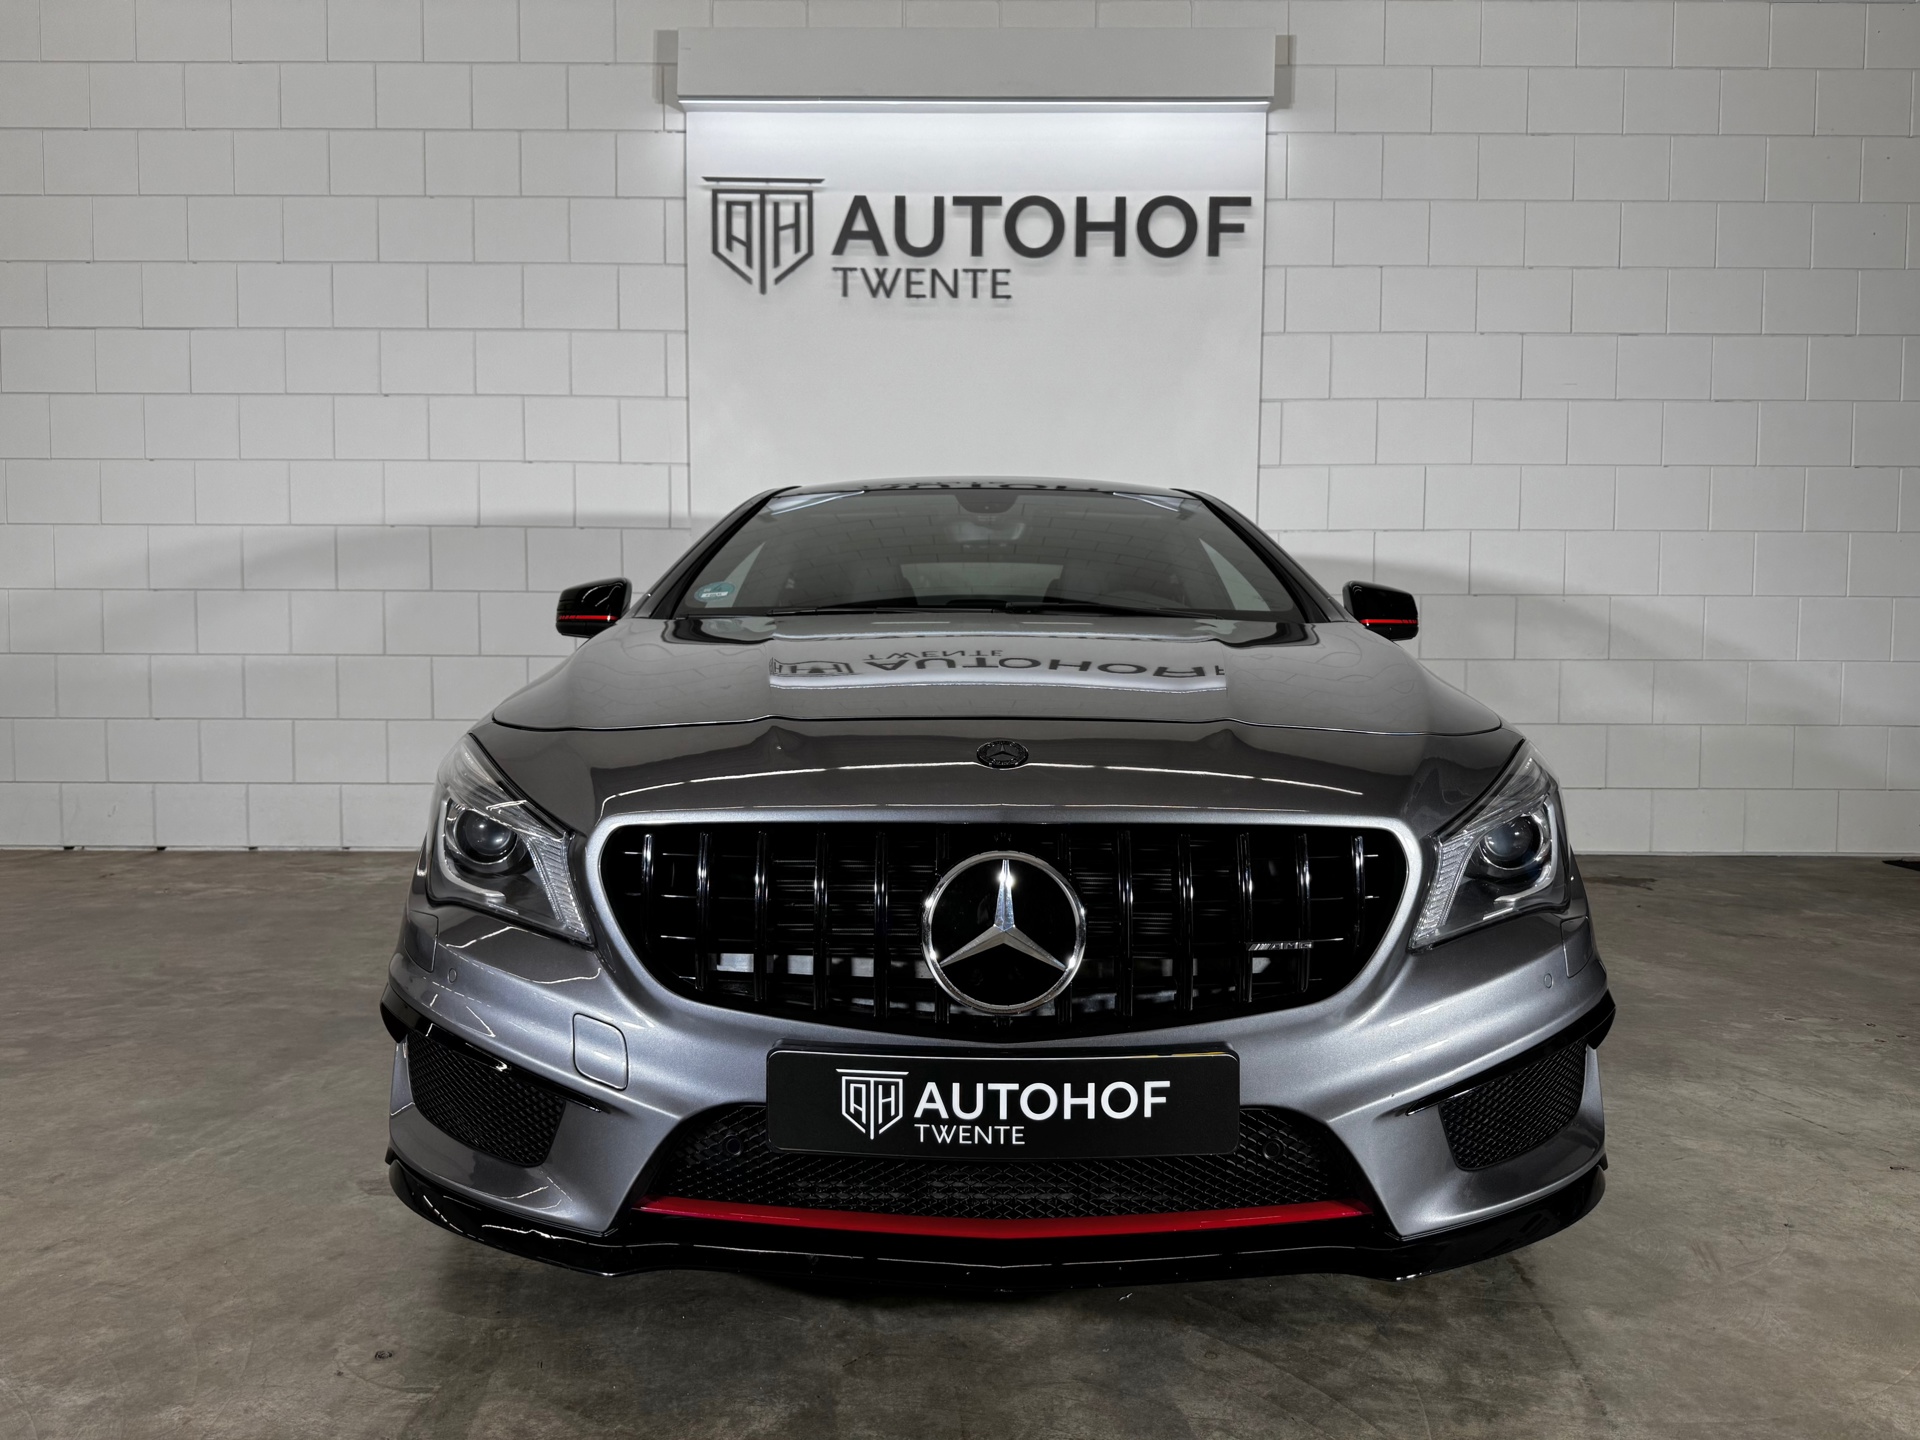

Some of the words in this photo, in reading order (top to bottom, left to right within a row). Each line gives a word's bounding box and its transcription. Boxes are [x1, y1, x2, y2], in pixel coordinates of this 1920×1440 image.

[832, 195, 1252, 259] AUTOHOF
[832, 267, 1013, 300] TWENTE
[914, 1080, 1171, 1121] AUTOHOF
[914, 1123, 1026, 1145] TWENTE
